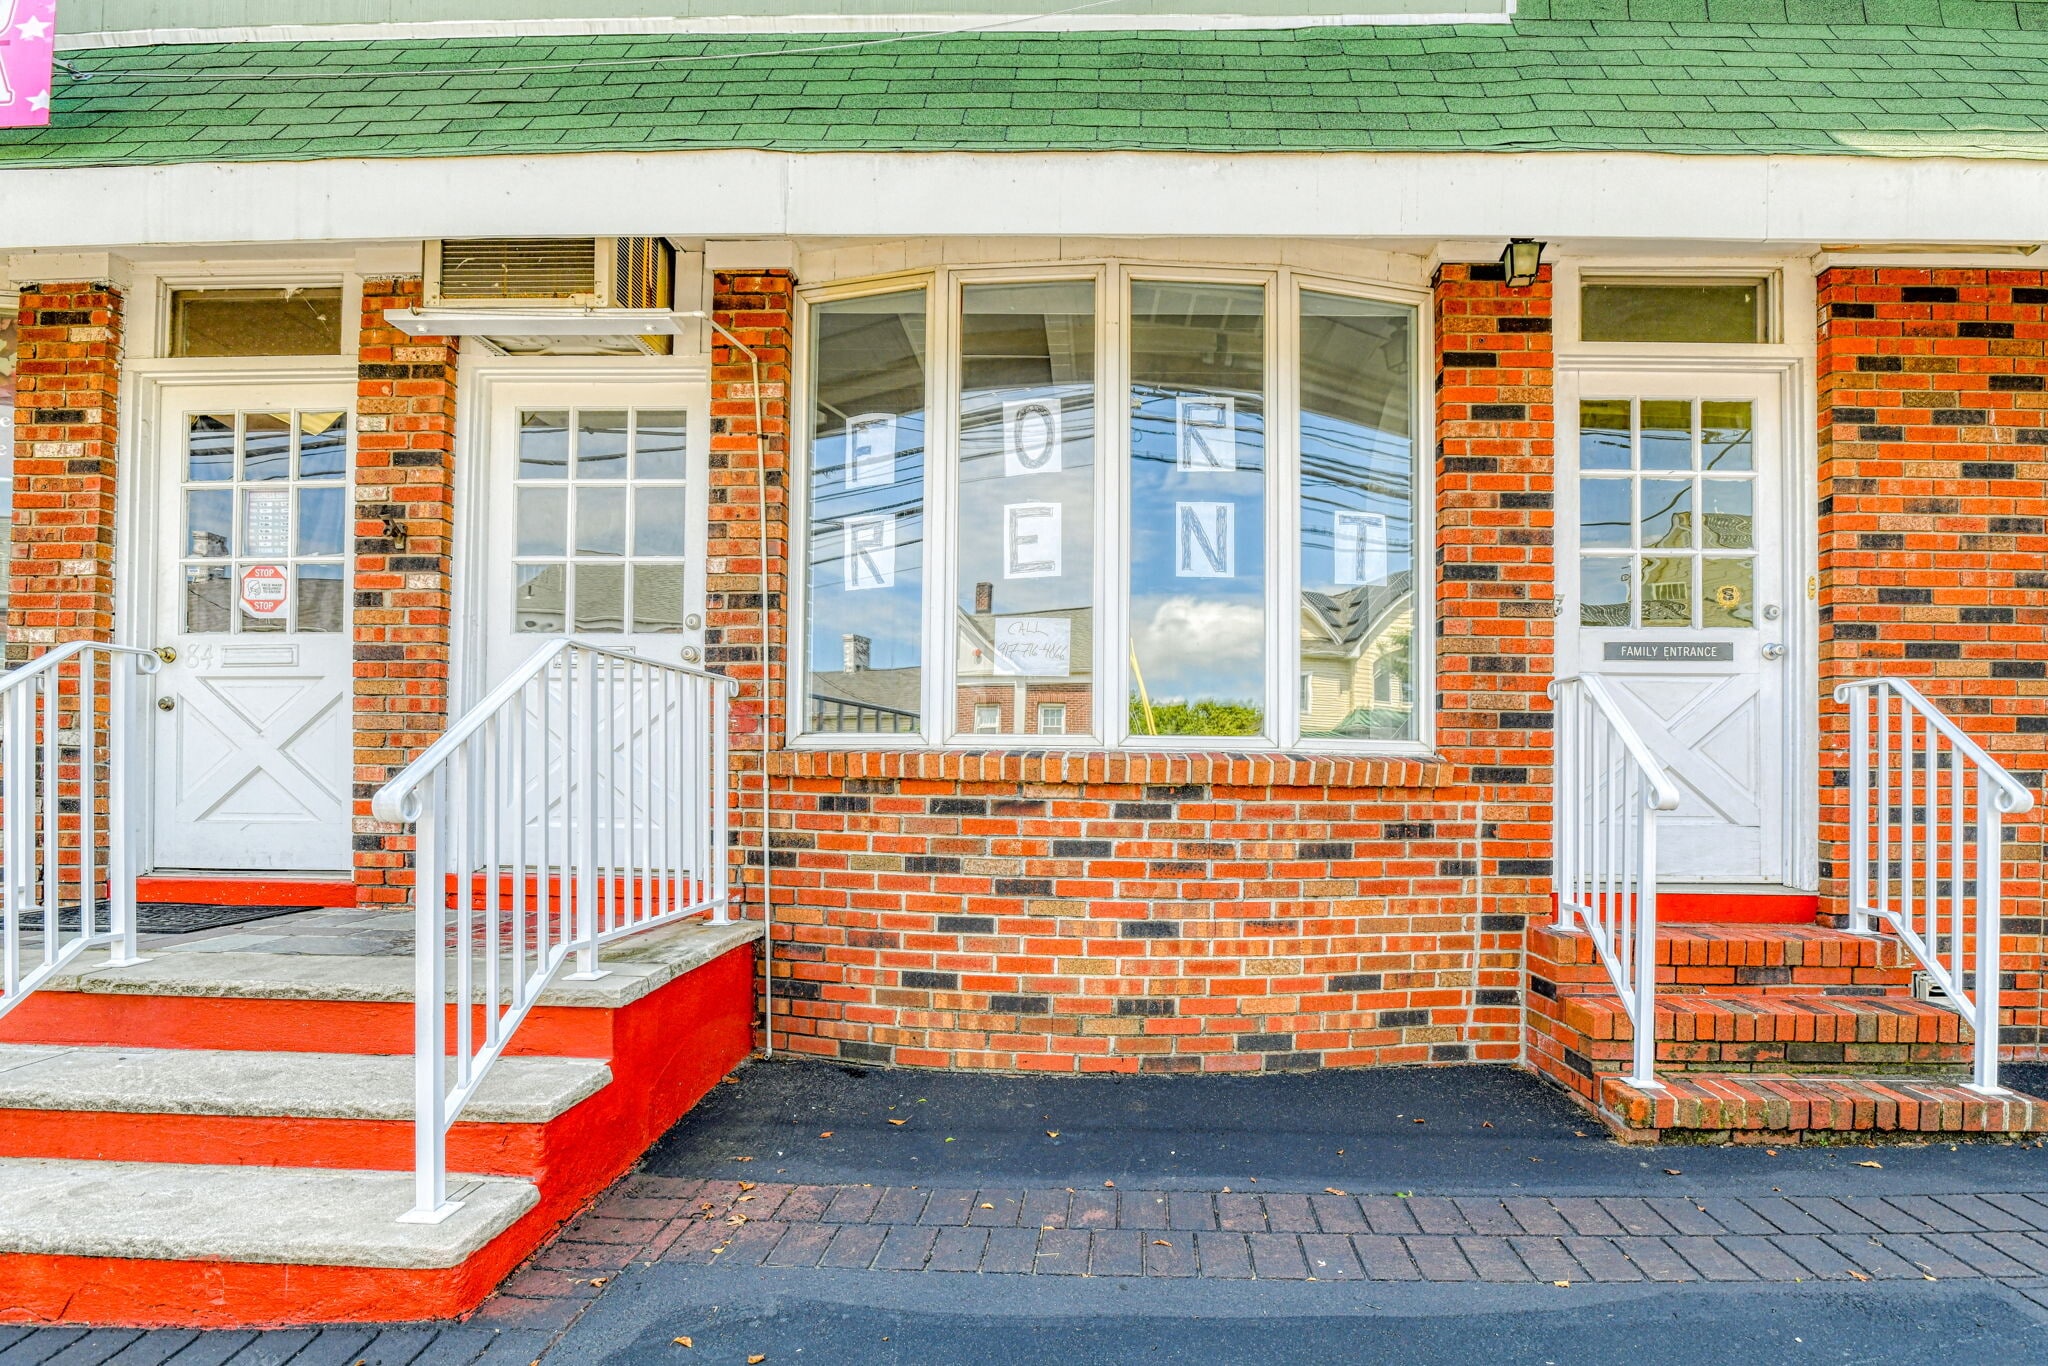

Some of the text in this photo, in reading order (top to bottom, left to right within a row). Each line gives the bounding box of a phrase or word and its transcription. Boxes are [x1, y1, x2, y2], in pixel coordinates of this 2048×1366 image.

[851, 402, 1227, 483] FOR
[850, 505, 1384, 587] RENT
[254, 602, 273, 610] STOP
[1008, 621, 1048, 636] CALL
[186, 643, 213, 670] 84
[1621, 646, 1717, 657] FAMILY ENTRANCE
